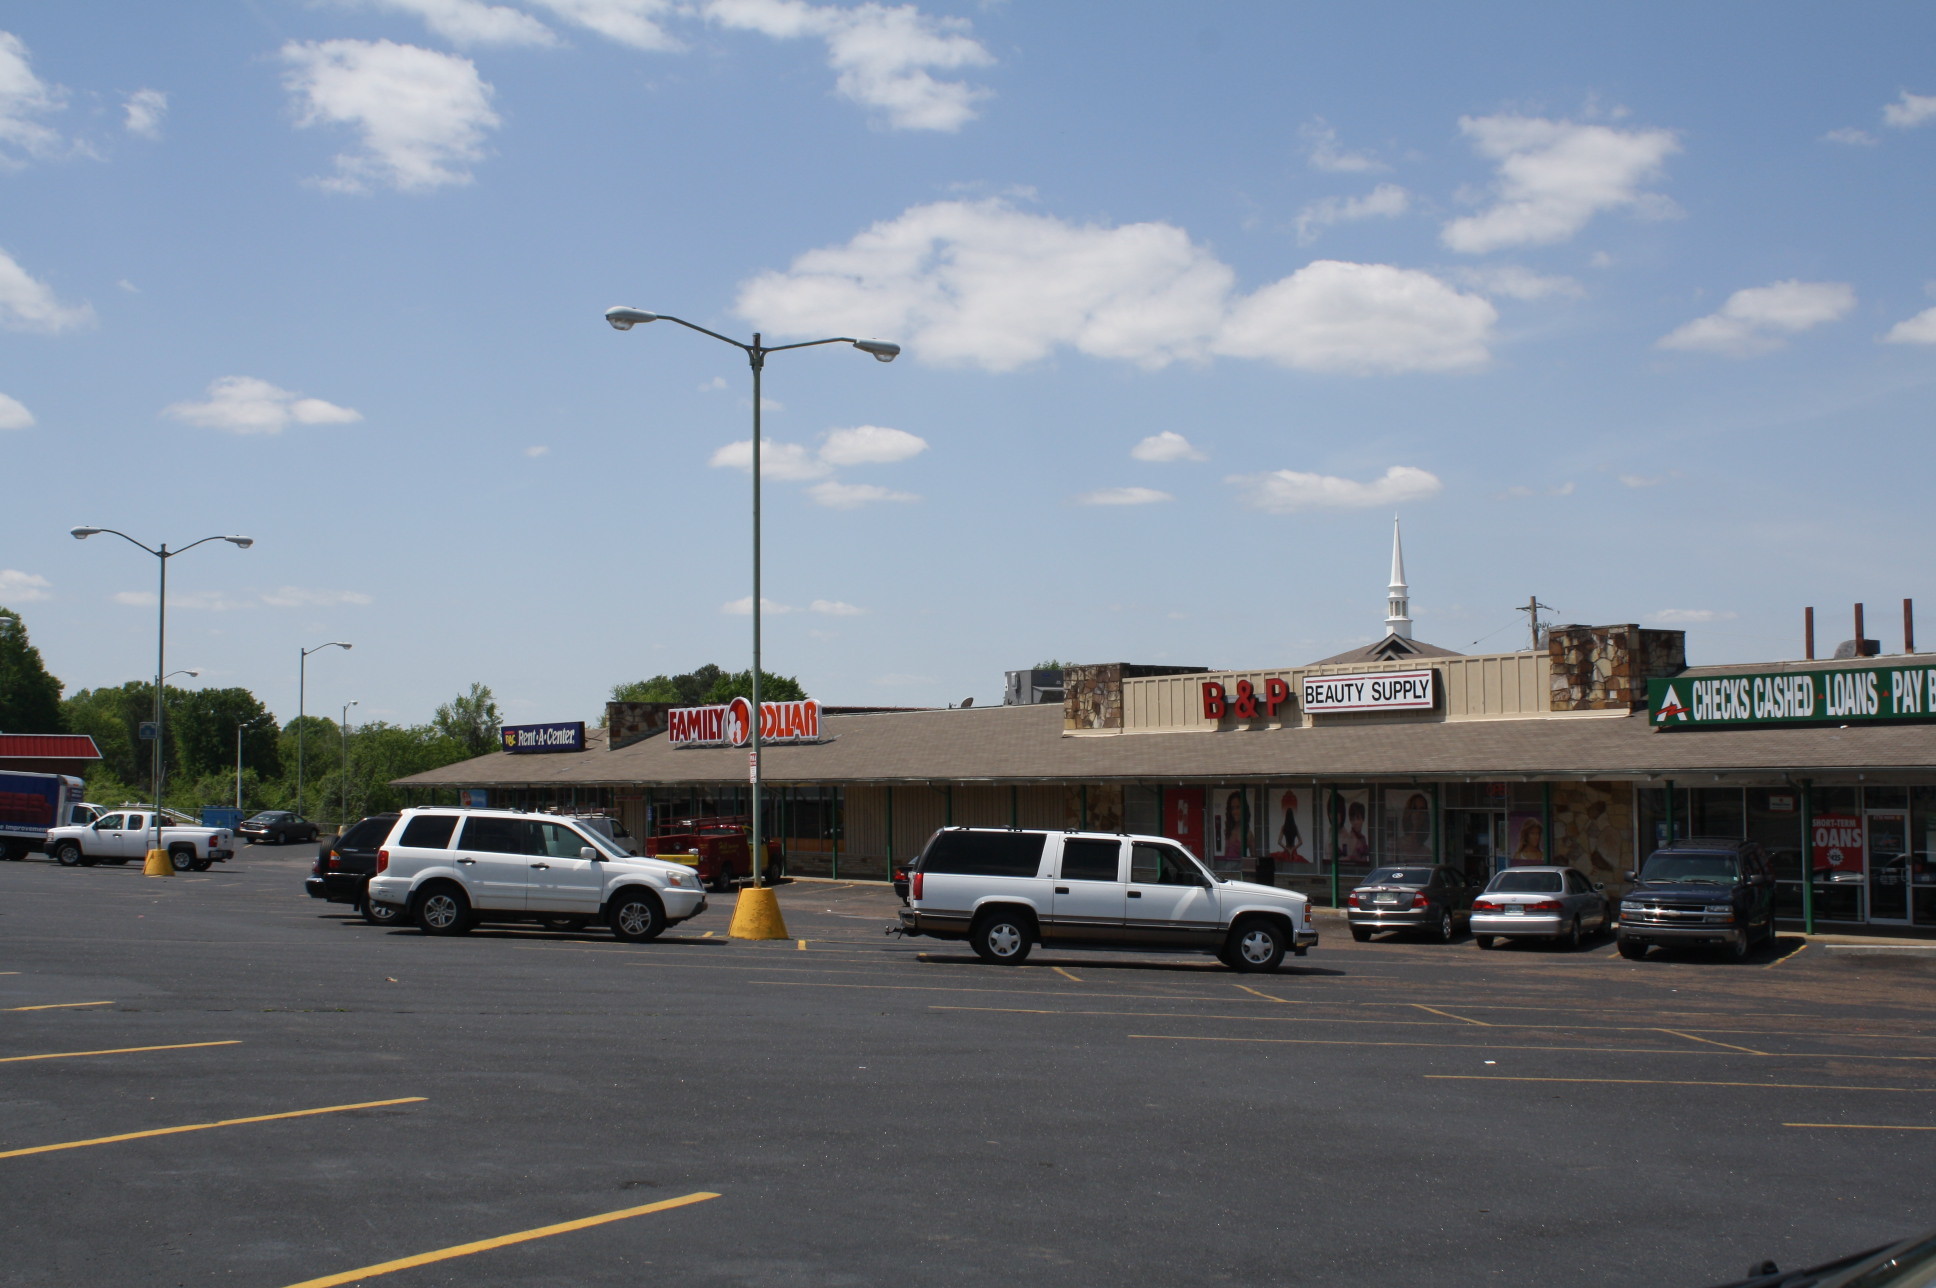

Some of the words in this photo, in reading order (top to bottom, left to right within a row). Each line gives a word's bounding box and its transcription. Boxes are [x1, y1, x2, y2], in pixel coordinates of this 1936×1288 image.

[1202, 681, 1227, 719] B
[1234, 679, 1260, 719] &
[1265, 677, 1290, 717] P
[1305, 683, 1365, 704] BEAUTY
[1371, 679, 1429, 702] SUPPLY
[1692, 677, 1750, 720] CHECKS
[1754, 675, 1814, 719] CASHED
[1825, 671, 1878, 716] LOANS
[1891, 670, 1924, 713] PAY
[669, 708, 726, 742] FAMILY
[6, 825, 49, 833] Improvemen
[1812, 819, 1856, 827] SHORT-TERM
